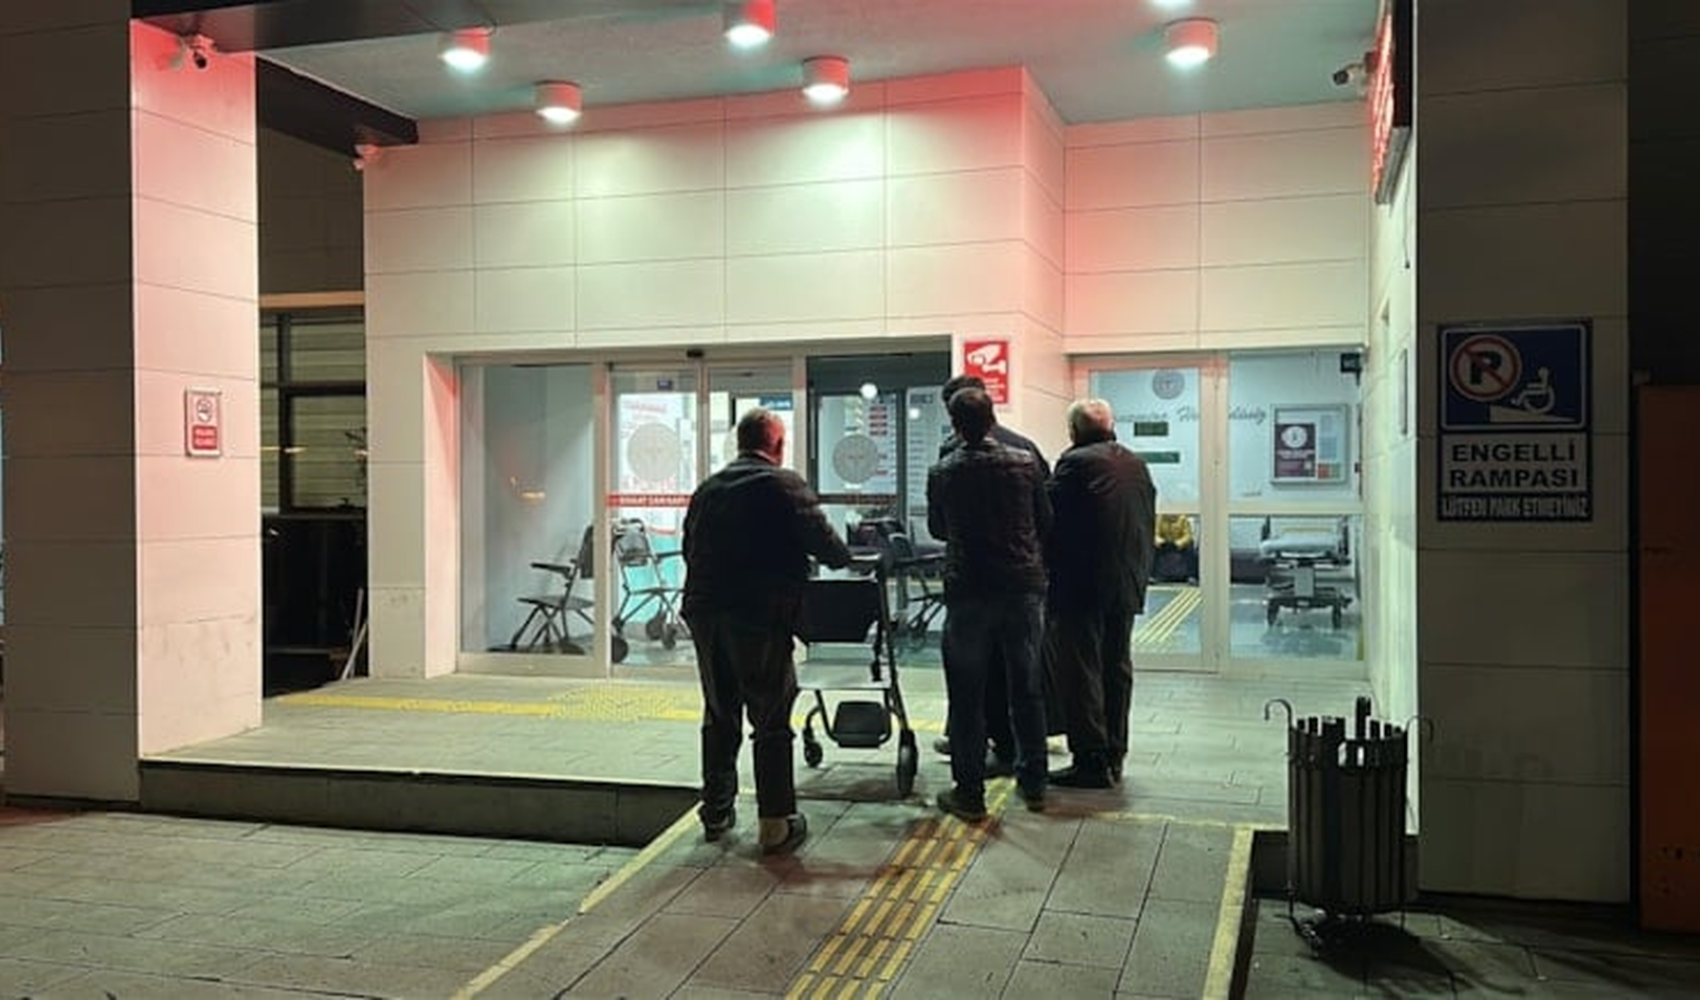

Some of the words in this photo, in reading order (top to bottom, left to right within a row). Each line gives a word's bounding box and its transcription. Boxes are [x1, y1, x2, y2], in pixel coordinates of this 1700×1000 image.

[1452, 438, 1576, 462] ENGELLİ
[1449, 469, 1578, 487] RAMPASI
[1489, 496, 1521, 517] PARK
